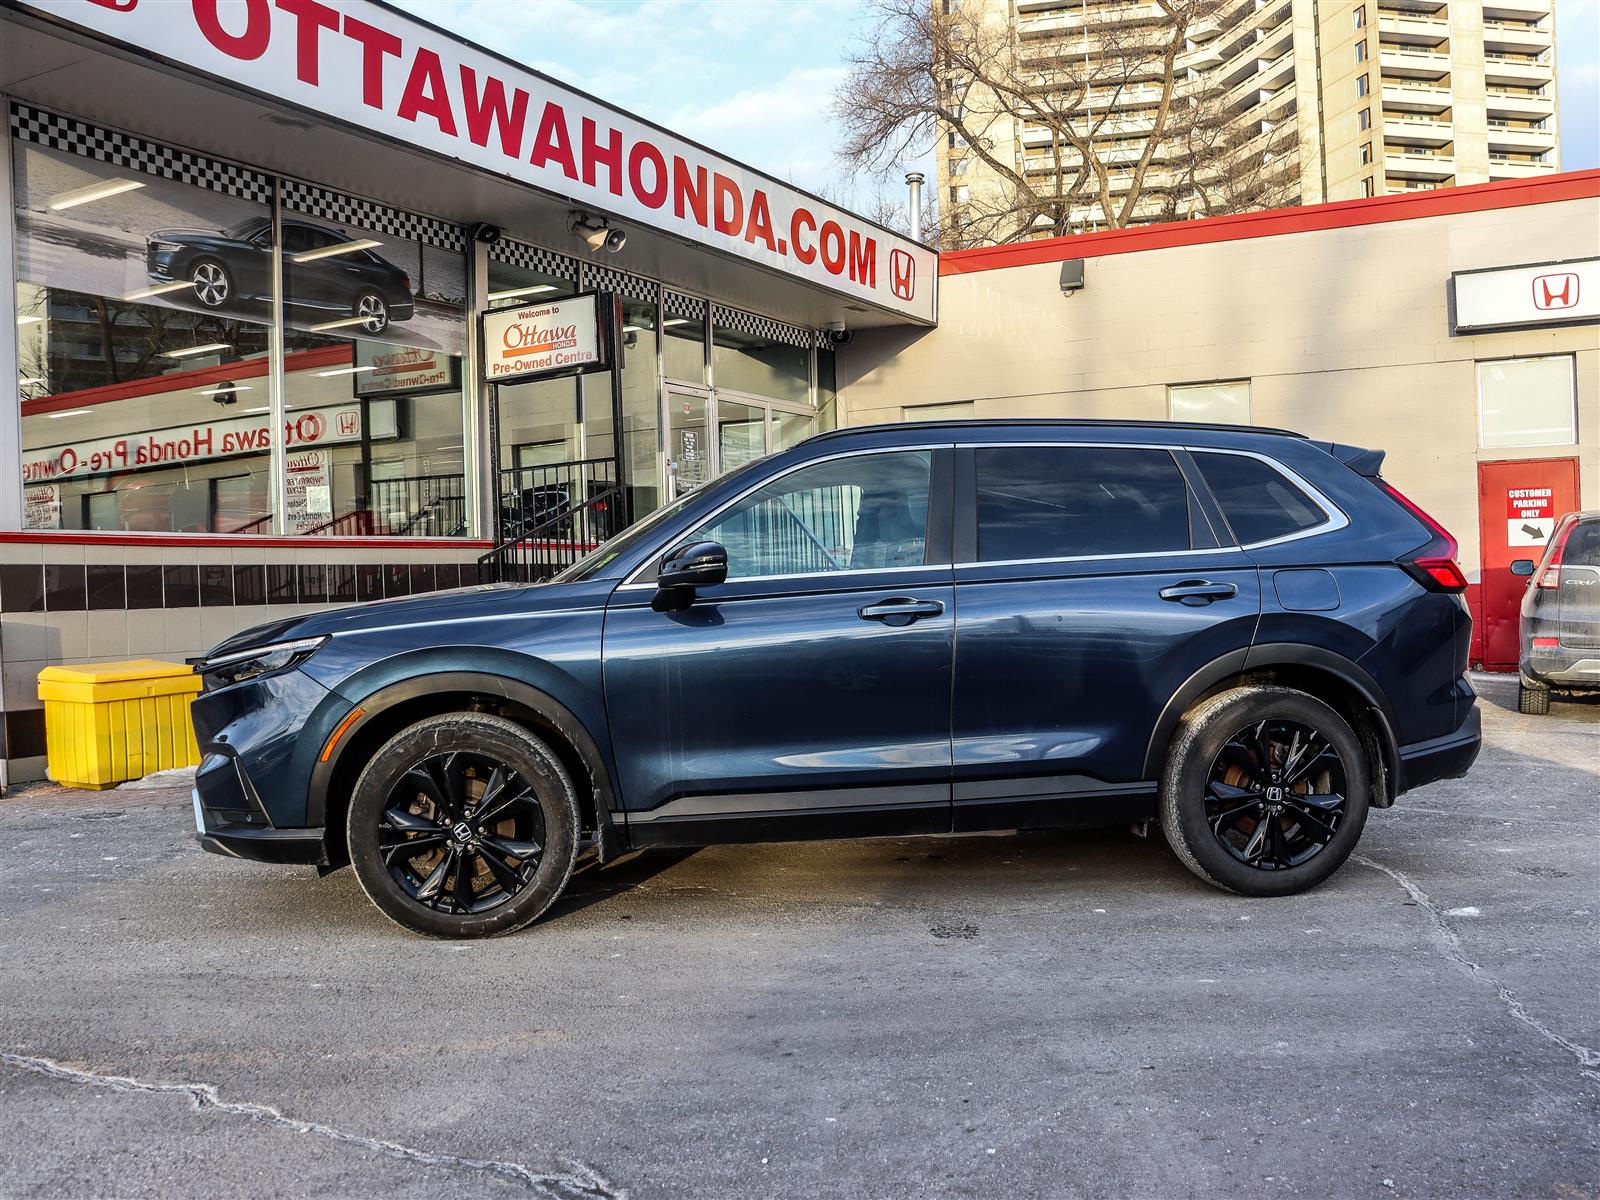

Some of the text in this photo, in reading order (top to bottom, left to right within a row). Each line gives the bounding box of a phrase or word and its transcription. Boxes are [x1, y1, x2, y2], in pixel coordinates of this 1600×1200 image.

[192, 0, 877, 289] OTTAWAHONDA.COM
[518, 306, 560, 320] Welcome to
[503, 323, 577, 349] Ottawa
[552, 340, 575, 349] HONDA
[493, 351, 592, 375] Pre-Owned Centre
[1508, 489, 1552, 498] CUSTOMER
[1513, 499, 1548, 508] PARKING
[1521, 509, 1540, 518] ONLY
